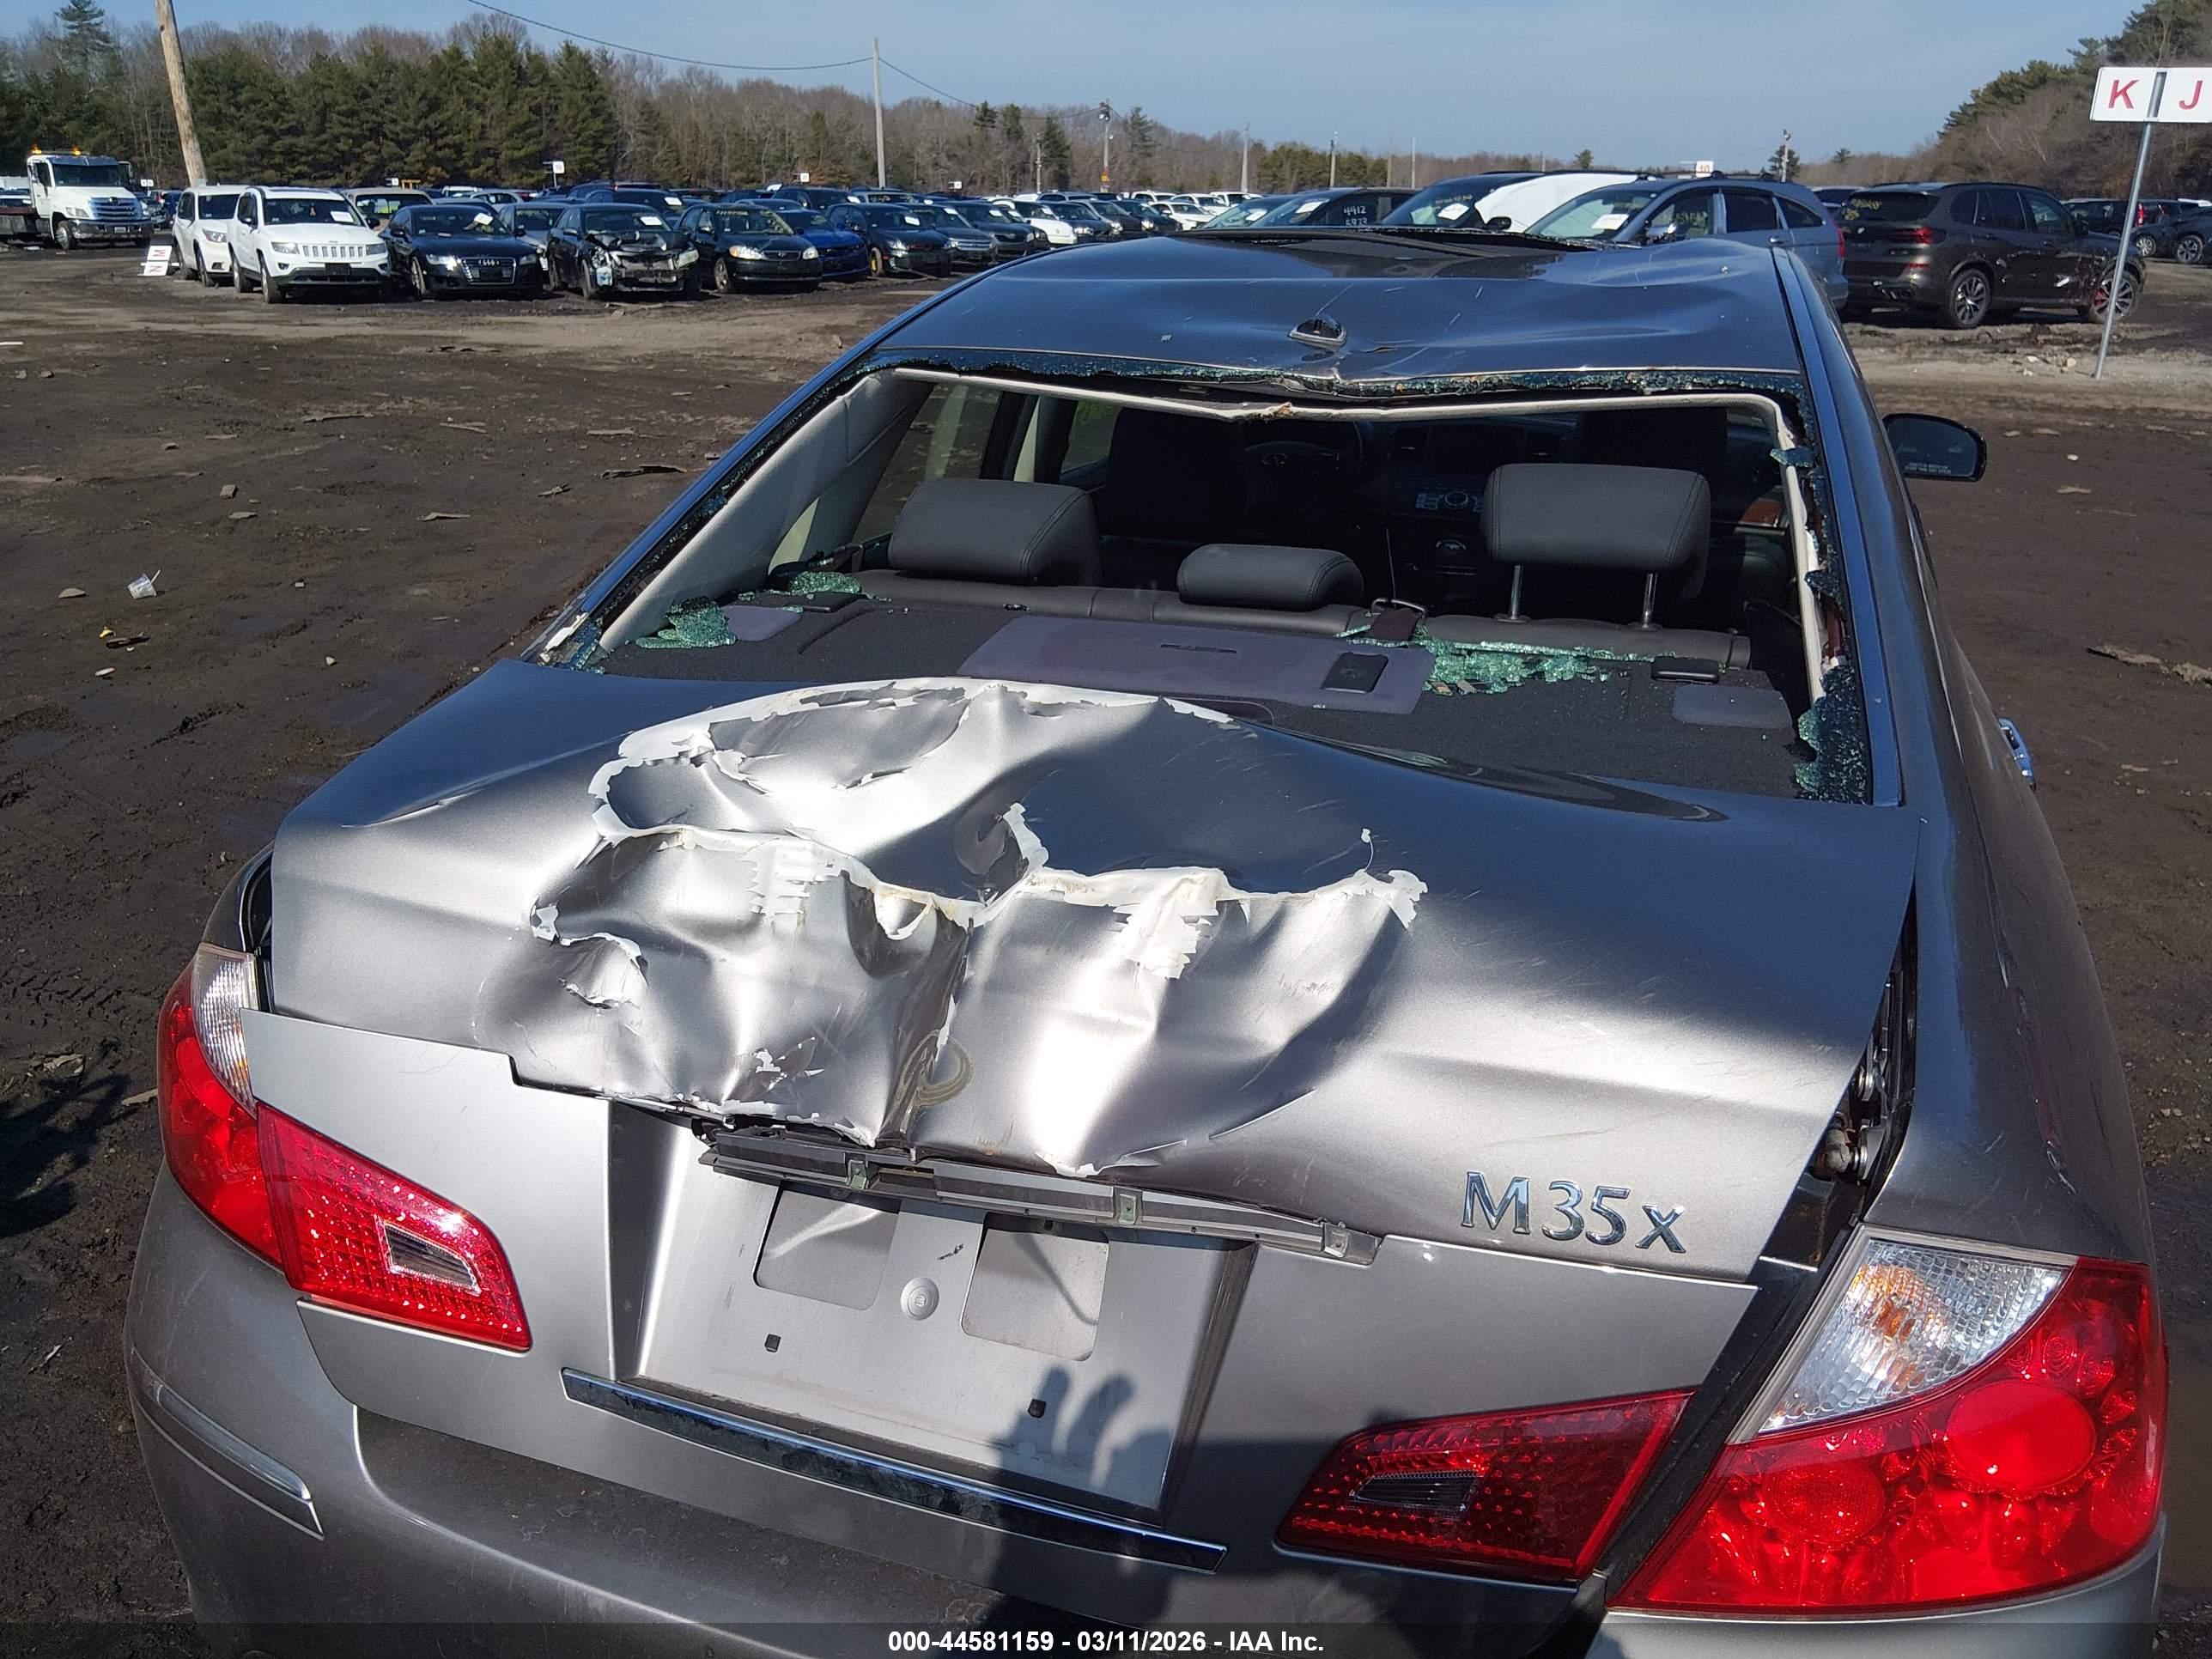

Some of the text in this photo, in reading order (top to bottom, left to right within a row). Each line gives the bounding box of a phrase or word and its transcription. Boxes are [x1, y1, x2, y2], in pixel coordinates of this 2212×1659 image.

[2108, 79, 2203, 110] K J
[1344, 205, 1367, 216] 4412
